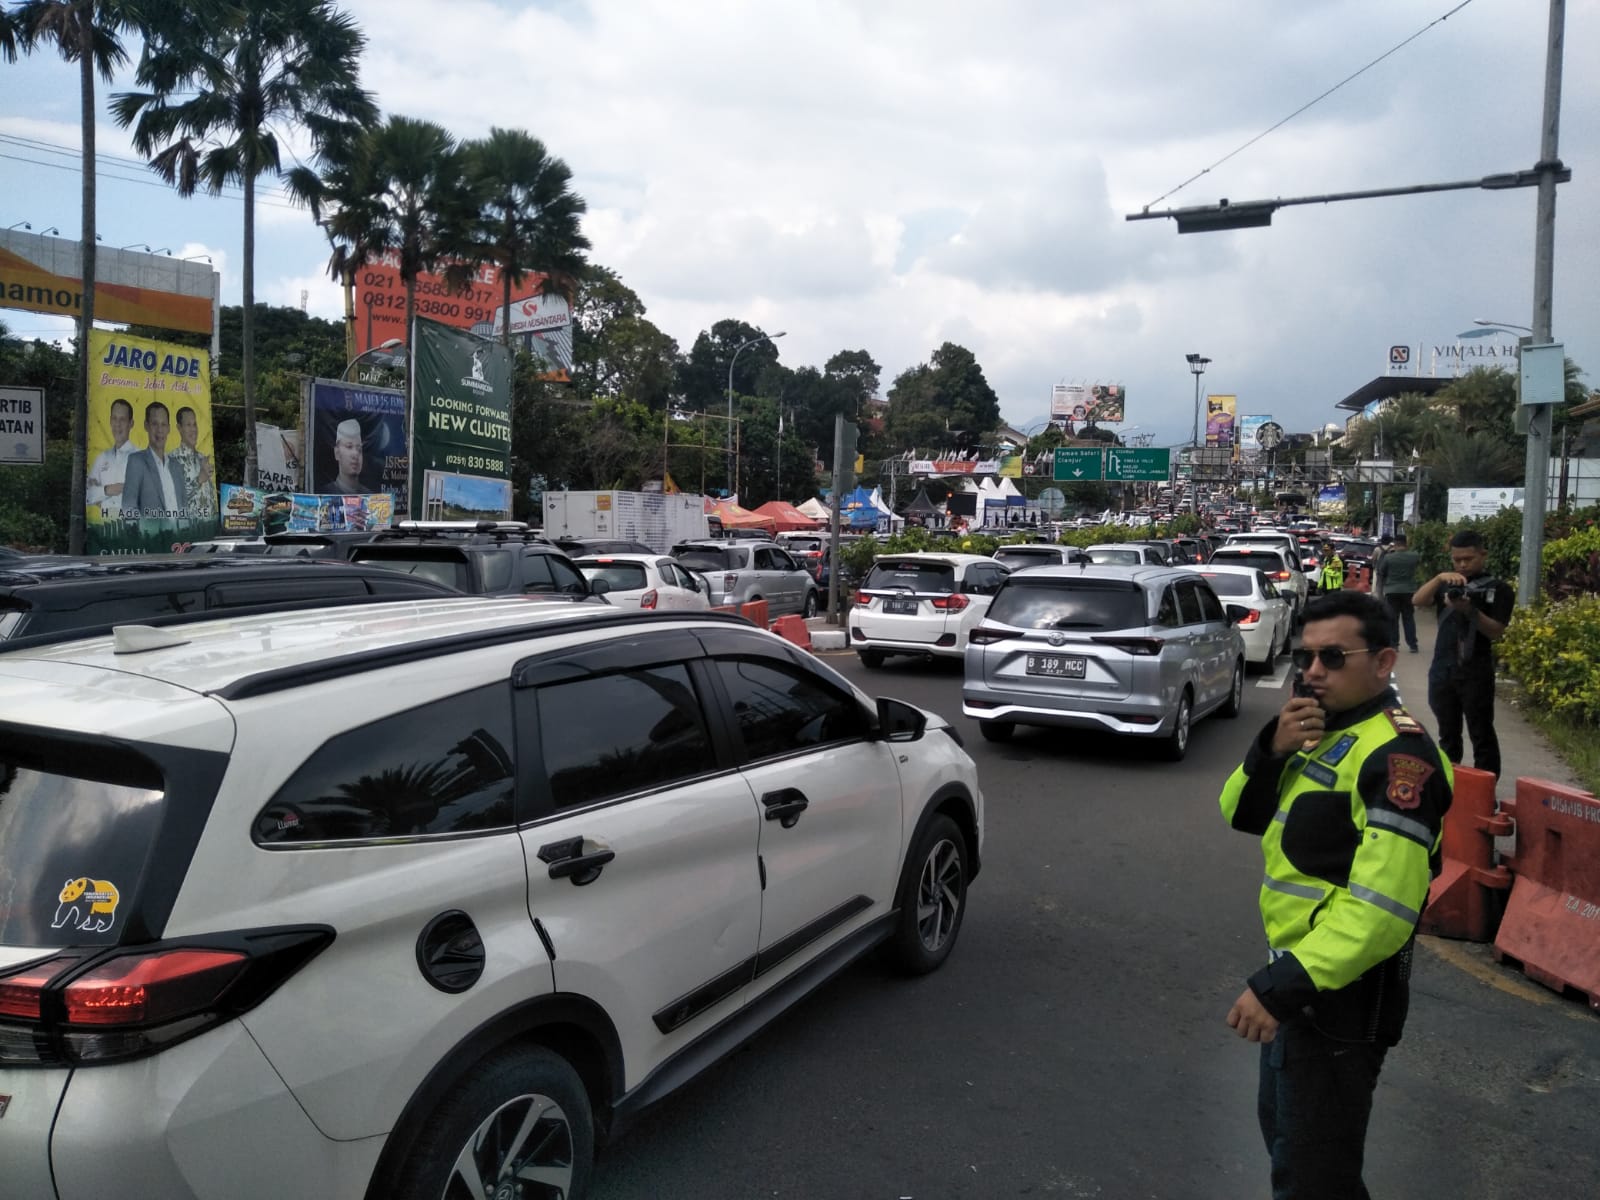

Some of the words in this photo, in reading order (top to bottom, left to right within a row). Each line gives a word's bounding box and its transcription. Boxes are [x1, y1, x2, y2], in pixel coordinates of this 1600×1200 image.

[364, 272, 394, 288] 021
[363, 291, 406, 310] 0812
[464, 306, 492, 321] 991
[528, 313, 567, 329] NUSANTARA
[103, 343, 157, 372] JARO
[160, 353, 200, 378] ADE
[1435, 345, 1497, 360] VIMALA
[430, 396, 473, 414] LOOKING
[428, 411, 467, 432] NEW
[468, 456, 484, 469] 830
[485, 458, 504, 473] 5888
[102, 508, 114, 518] H.
[119, 508, 140, 518] Ade
[197, 508, 209, 518] SE
[1028, 658, 1034, 667] B
[1041, 659, 1058, 669] 189
